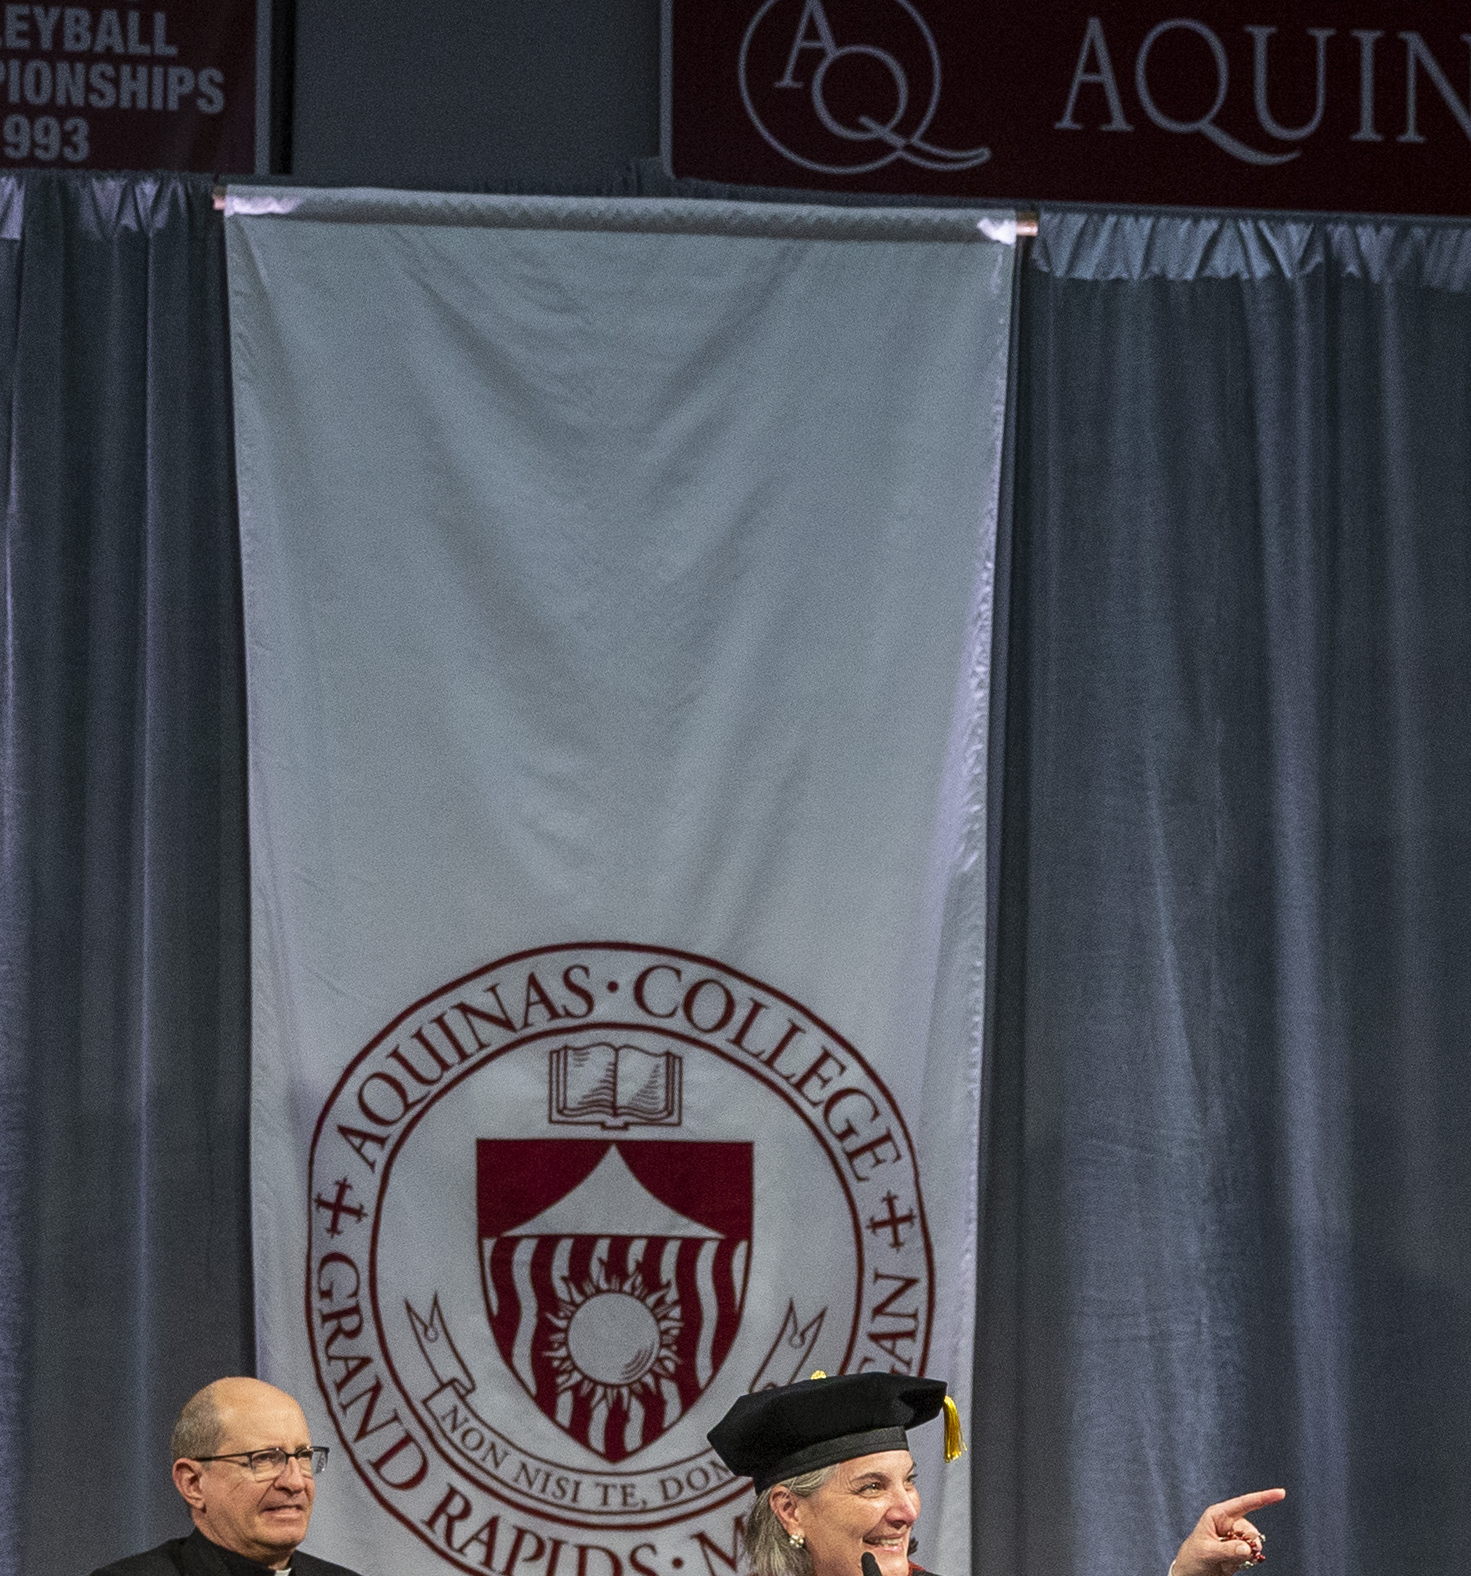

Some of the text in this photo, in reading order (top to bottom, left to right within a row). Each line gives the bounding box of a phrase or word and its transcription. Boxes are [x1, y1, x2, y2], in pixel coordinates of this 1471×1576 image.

[336, 964, 906, 1183] AQUINAS COLLEGE
[317, 1251, 430, 1491] GRAND
[440, 1404, 510, 1471] NON
[513, 1461, 583, 1504] NISI
